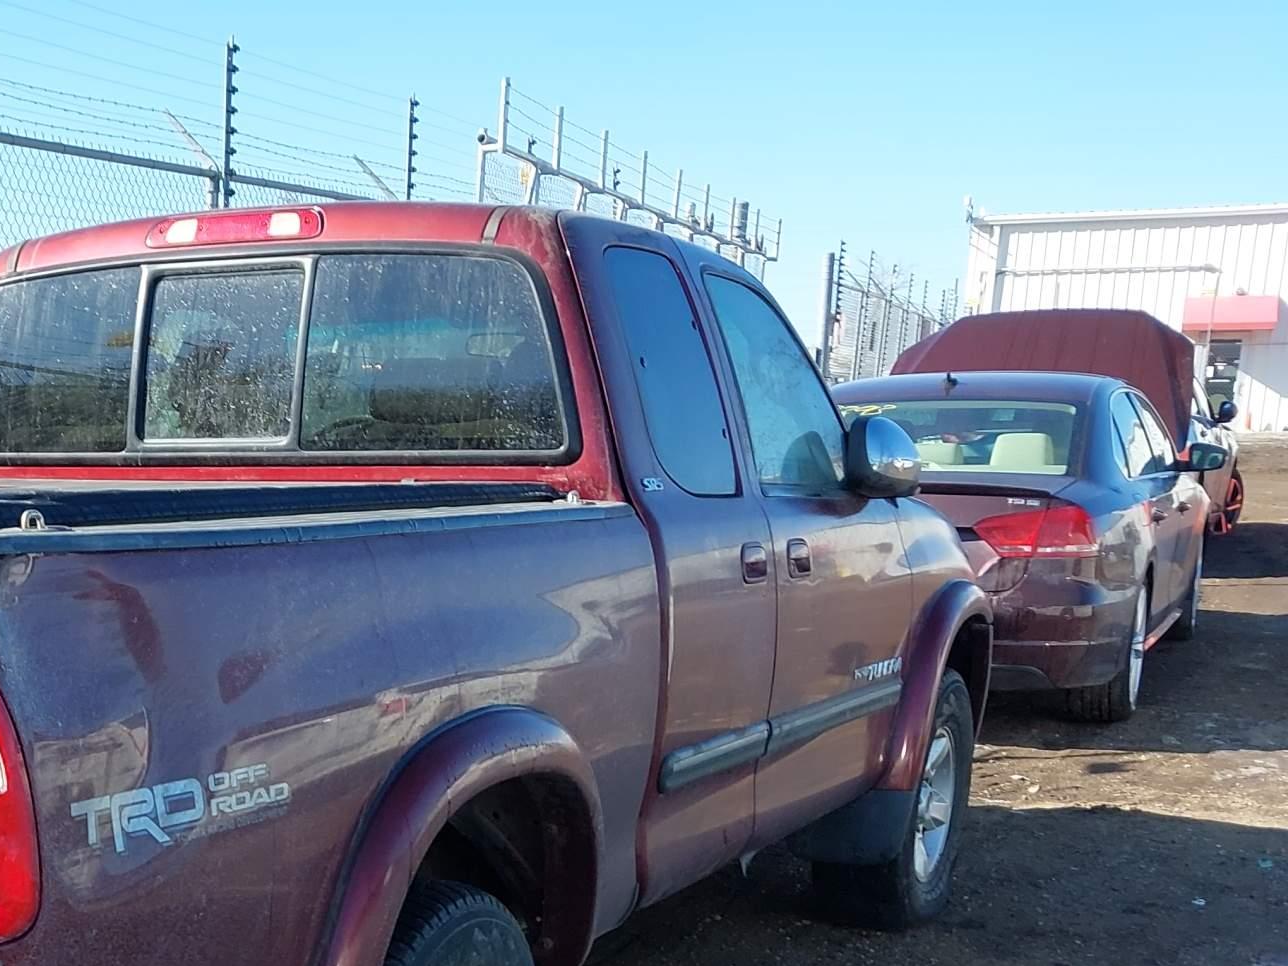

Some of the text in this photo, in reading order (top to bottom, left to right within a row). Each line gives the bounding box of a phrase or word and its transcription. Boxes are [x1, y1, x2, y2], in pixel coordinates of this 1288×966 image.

[208, 763, 267, 792] OFF
[70, 778, 205, 854] TRD
[210, 782, 289, 817] ROAD
